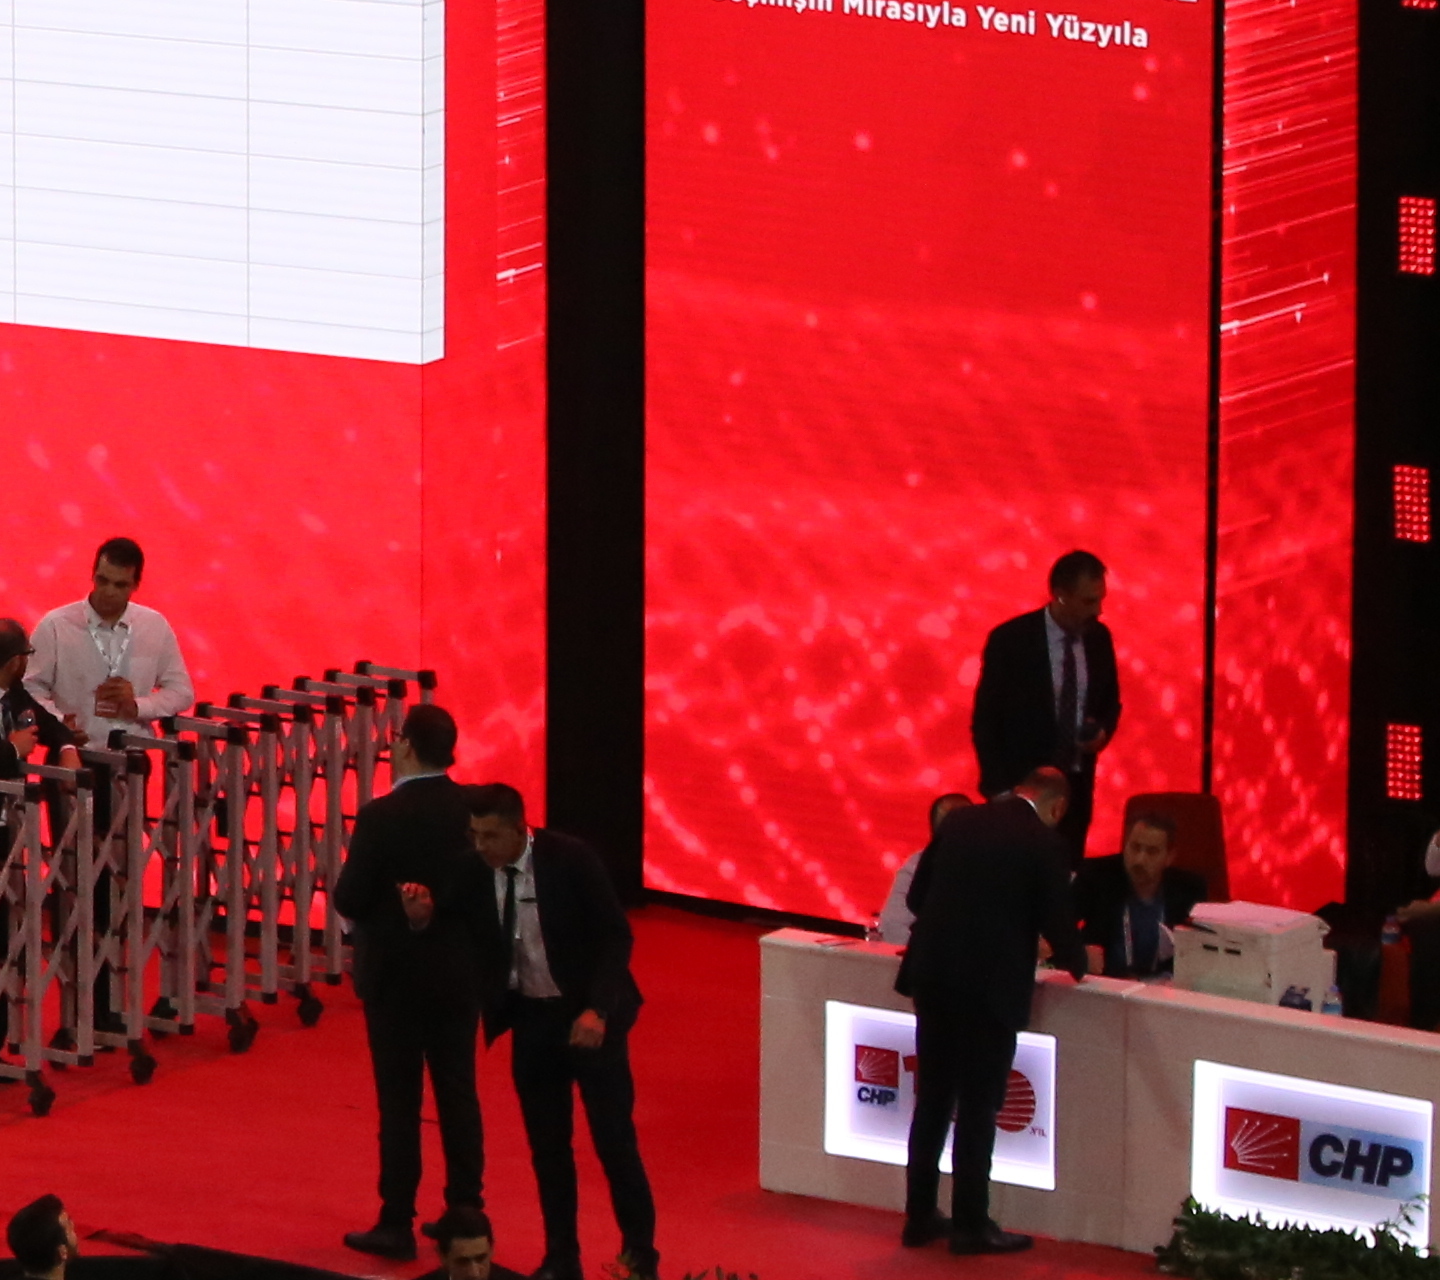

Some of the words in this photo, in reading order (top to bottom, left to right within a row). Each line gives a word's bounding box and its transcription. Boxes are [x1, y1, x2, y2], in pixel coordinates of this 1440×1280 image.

[976, 4, 1037, 37] Yeni
[1045, 11, 1149, 50] Yüzyıla
[857, 1086, 897, 1106] CHP
[1308, 1133, 1414, 1188] CHP
